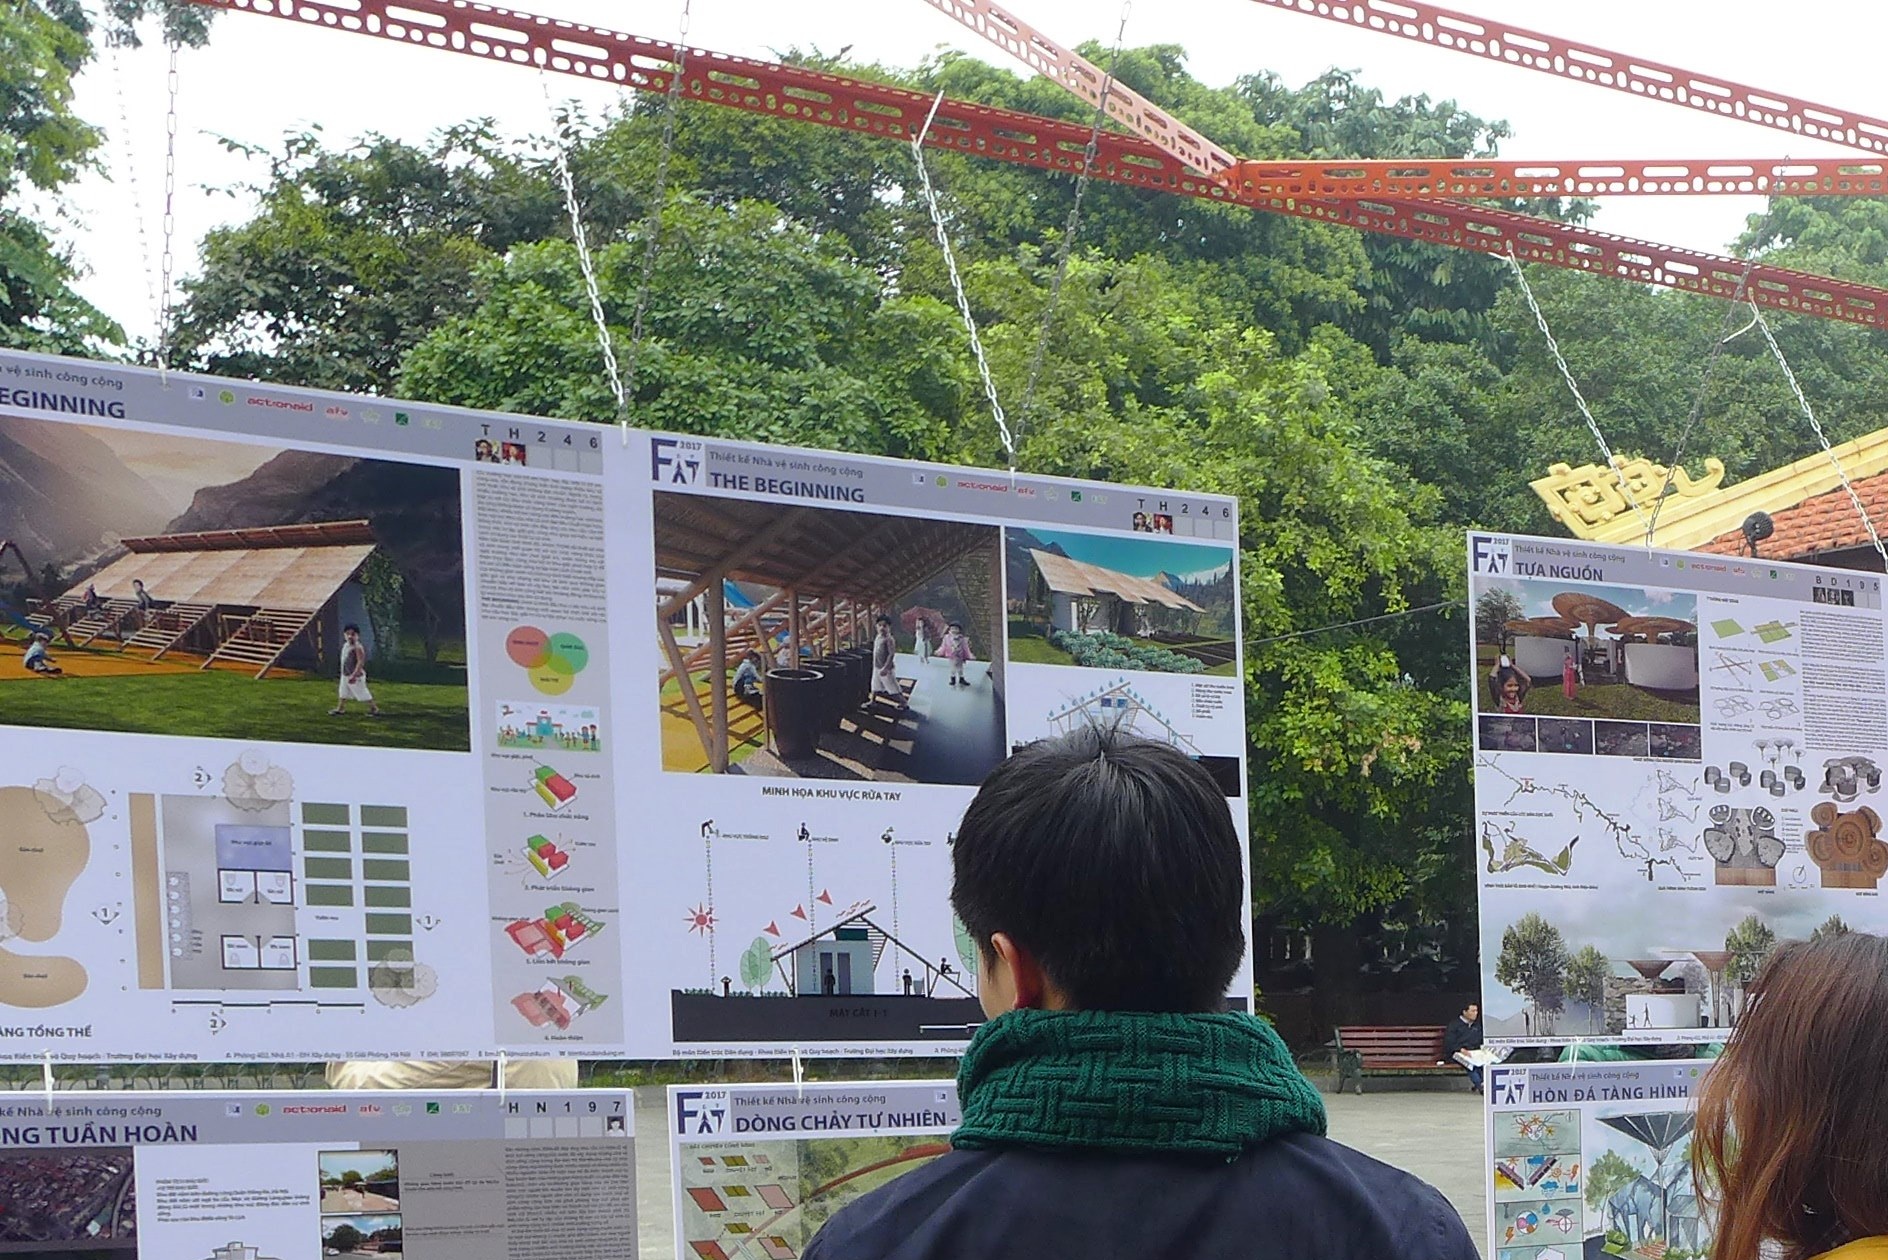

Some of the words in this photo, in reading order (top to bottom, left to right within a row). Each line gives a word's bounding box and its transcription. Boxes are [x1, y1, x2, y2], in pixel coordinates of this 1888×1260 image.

[25, 367, 52, 379] sinh
[480, 424, 490, 436] T
[509, 429, 520, 440] H
[538, 431, 547, 443] 2
[563, 434, 572, 446] 4
[589, 437, 598, 449] 6
[679, 441, 702, 450] 2017
[709, 451, 735, 462] Thiết
[752, 456, 772, 467] Nhà
[789, 461, 811, 472] sinh
[710, 472, 750, 491] THE
[755, 477, 865, 503] BEGINNING
[1137, 498, 1146, 509] T
[1159, 501, 1168, 512] H
[1181, 503, 1189, 514] 2
[1202, 506, 1209, 517] 4
[1222, 507, 1230, 518] 6
[762, 786, 789, 796] MINH
[816, 789, 837, 798] KHU
[884, 792, 901, 801] TAY
[704, 1091, 727, 1100] 2017
[734, 1096, 760, 1107] Thiết
[777, 1095, 797, 1105] Nhà
[813, 1094, 834, 1104] sinh
[1533, 1087, 1568, 1103] HÒN
[1573, 1085, 1596, 1101] ĐÁ
[1602, 1084, 1644, 1100] TÀNG
[1650, 1083, 1688, 1099] HÌNH
[18, 1106, 44, 1117] Nhà
[66, 1106, 93, 1116] sinh
[96, 1106, 127, 1118] công
[131, 1106, 162, 1118] cộng
[508, 1102, 519, 1114] H
[536, 1102, 547, 1113] N
[588, 1101, 597, 1112] 9
[613, 1101, 621, 1112] 7
[736, 1112, 796, 1133] DÒNG
[801, 1109, 852, 1131] CHẢY
[887, 1111, 947, 1128] NHIÊN
[45, 1121, 117, 1145] TUẦN
[124, 1121, 198, 1143] HOÀN
